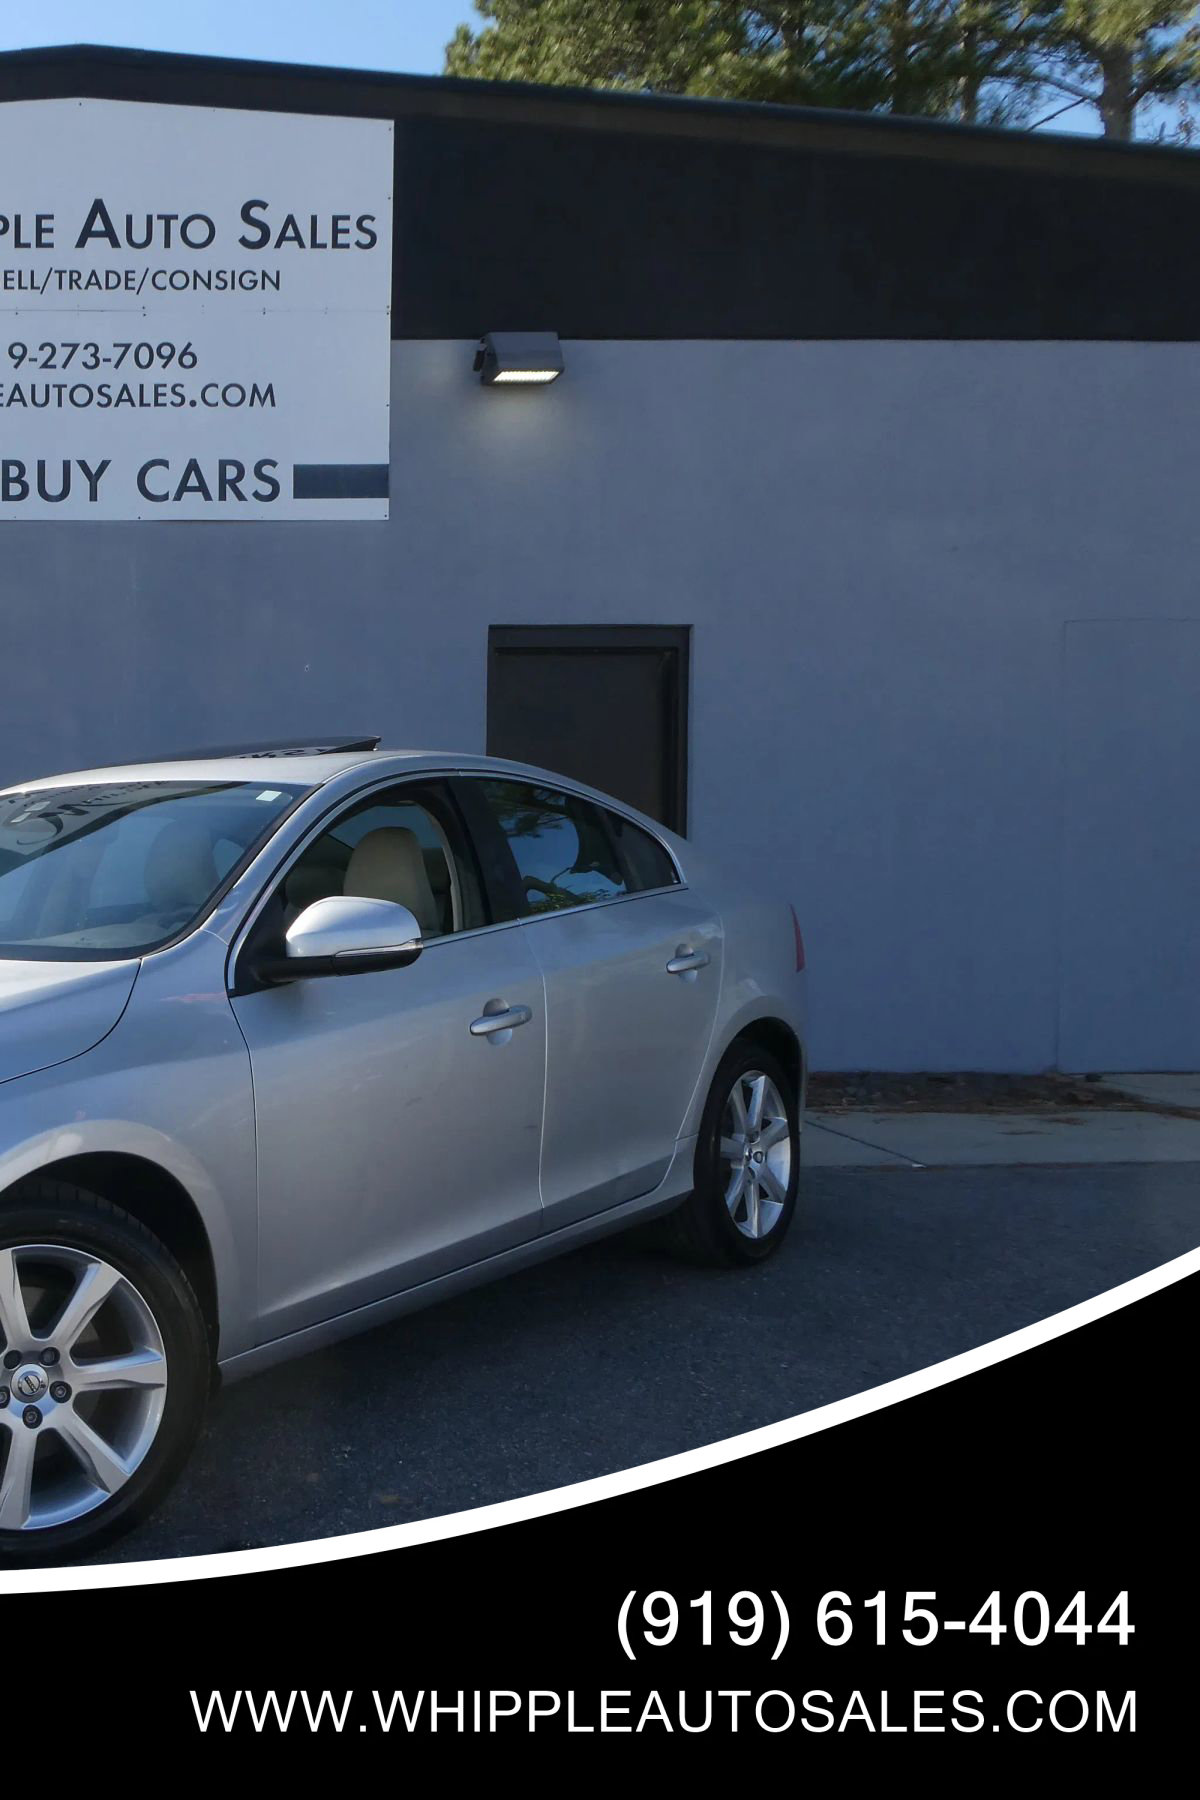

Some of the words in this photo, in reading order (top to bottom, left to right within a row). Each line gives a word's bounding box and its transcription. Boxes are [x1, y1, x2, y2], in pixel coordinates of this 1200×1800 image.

[74, 198, 217, 250] AUTO
[238, 199, 378, 250] SALES
[1, 459, 112, 503] BUY
[136, 458, 282, 503] CARS
